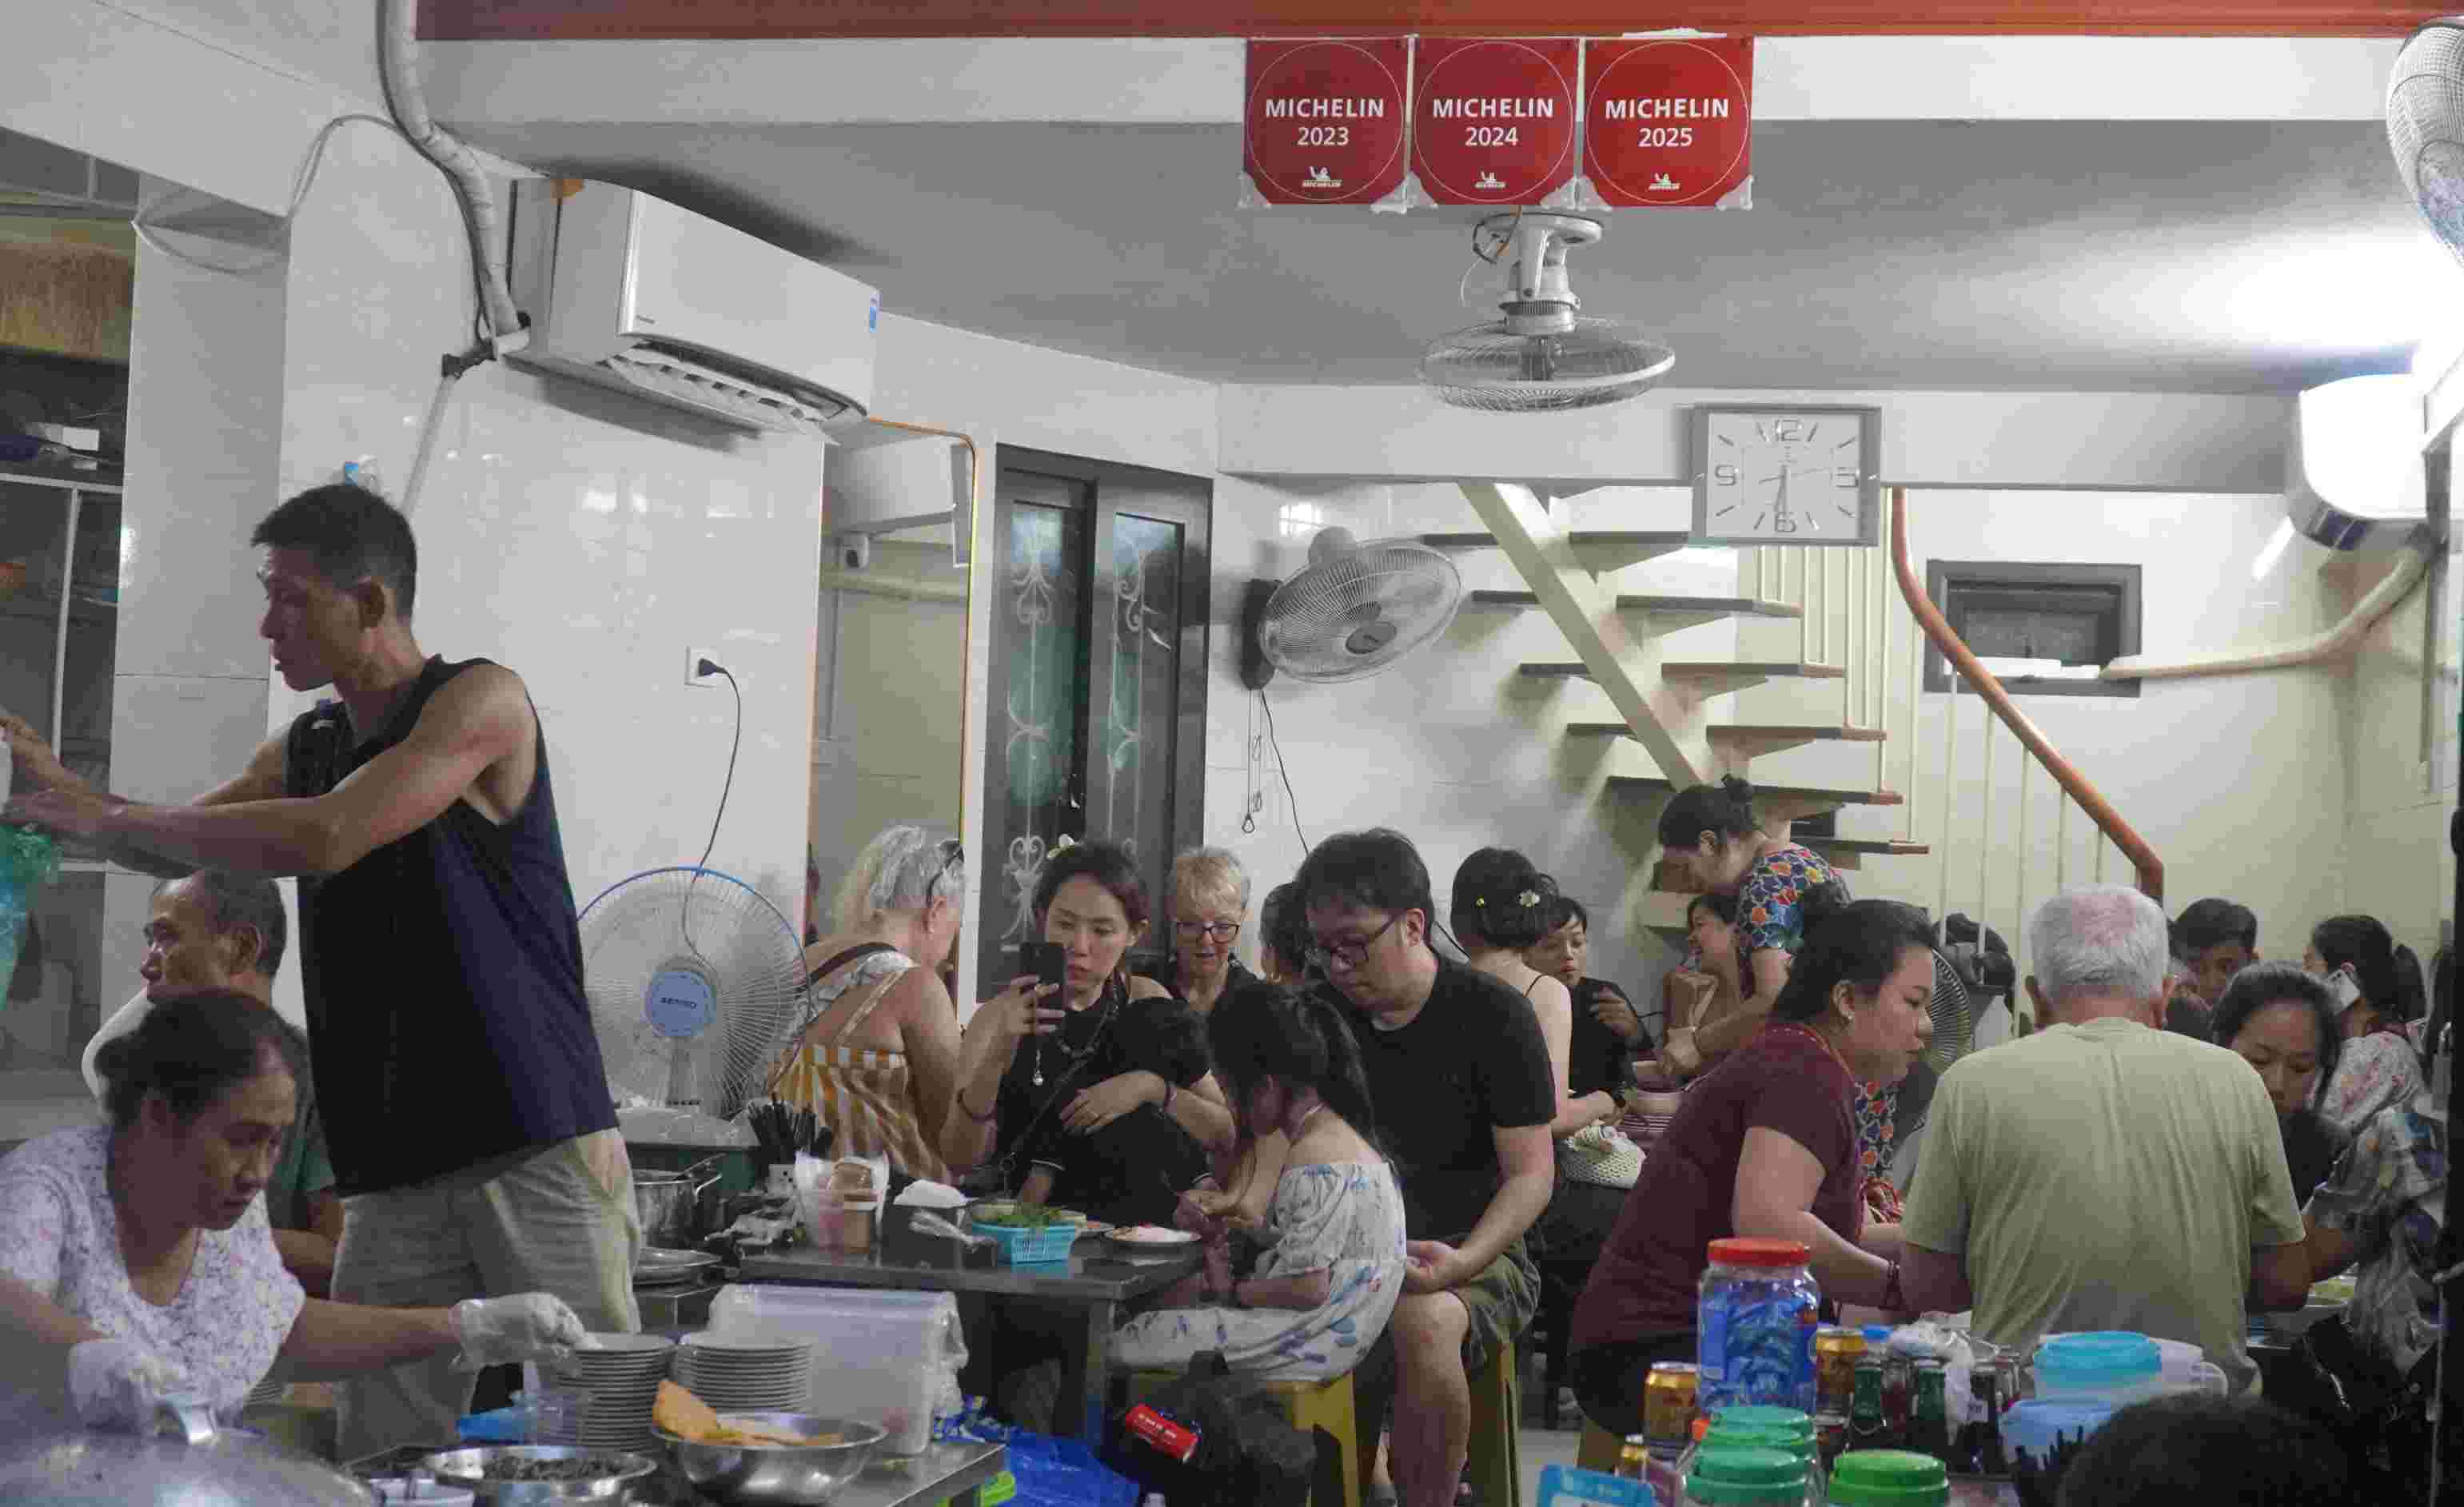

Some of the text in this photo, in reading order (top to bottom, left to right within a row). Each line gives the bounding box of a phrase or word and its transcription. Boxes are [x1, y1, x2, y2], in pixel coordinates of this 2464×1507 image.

[1266, 98, 1384, 118] MICHELIN
[1433, 98, 1554, 118] MICHELIN
[1605, 98, 1728, 119] MICHELIN
[1298, 126, 1350, 146] 2023
[1465, 126, 1518, 146] 2024
[1638, 127, 1693, 147] 2025
[1773, 419, 1802, 441] 12
[1715, 464, 1739, 486] 9
[1773, 511, 1798, 533] 6
